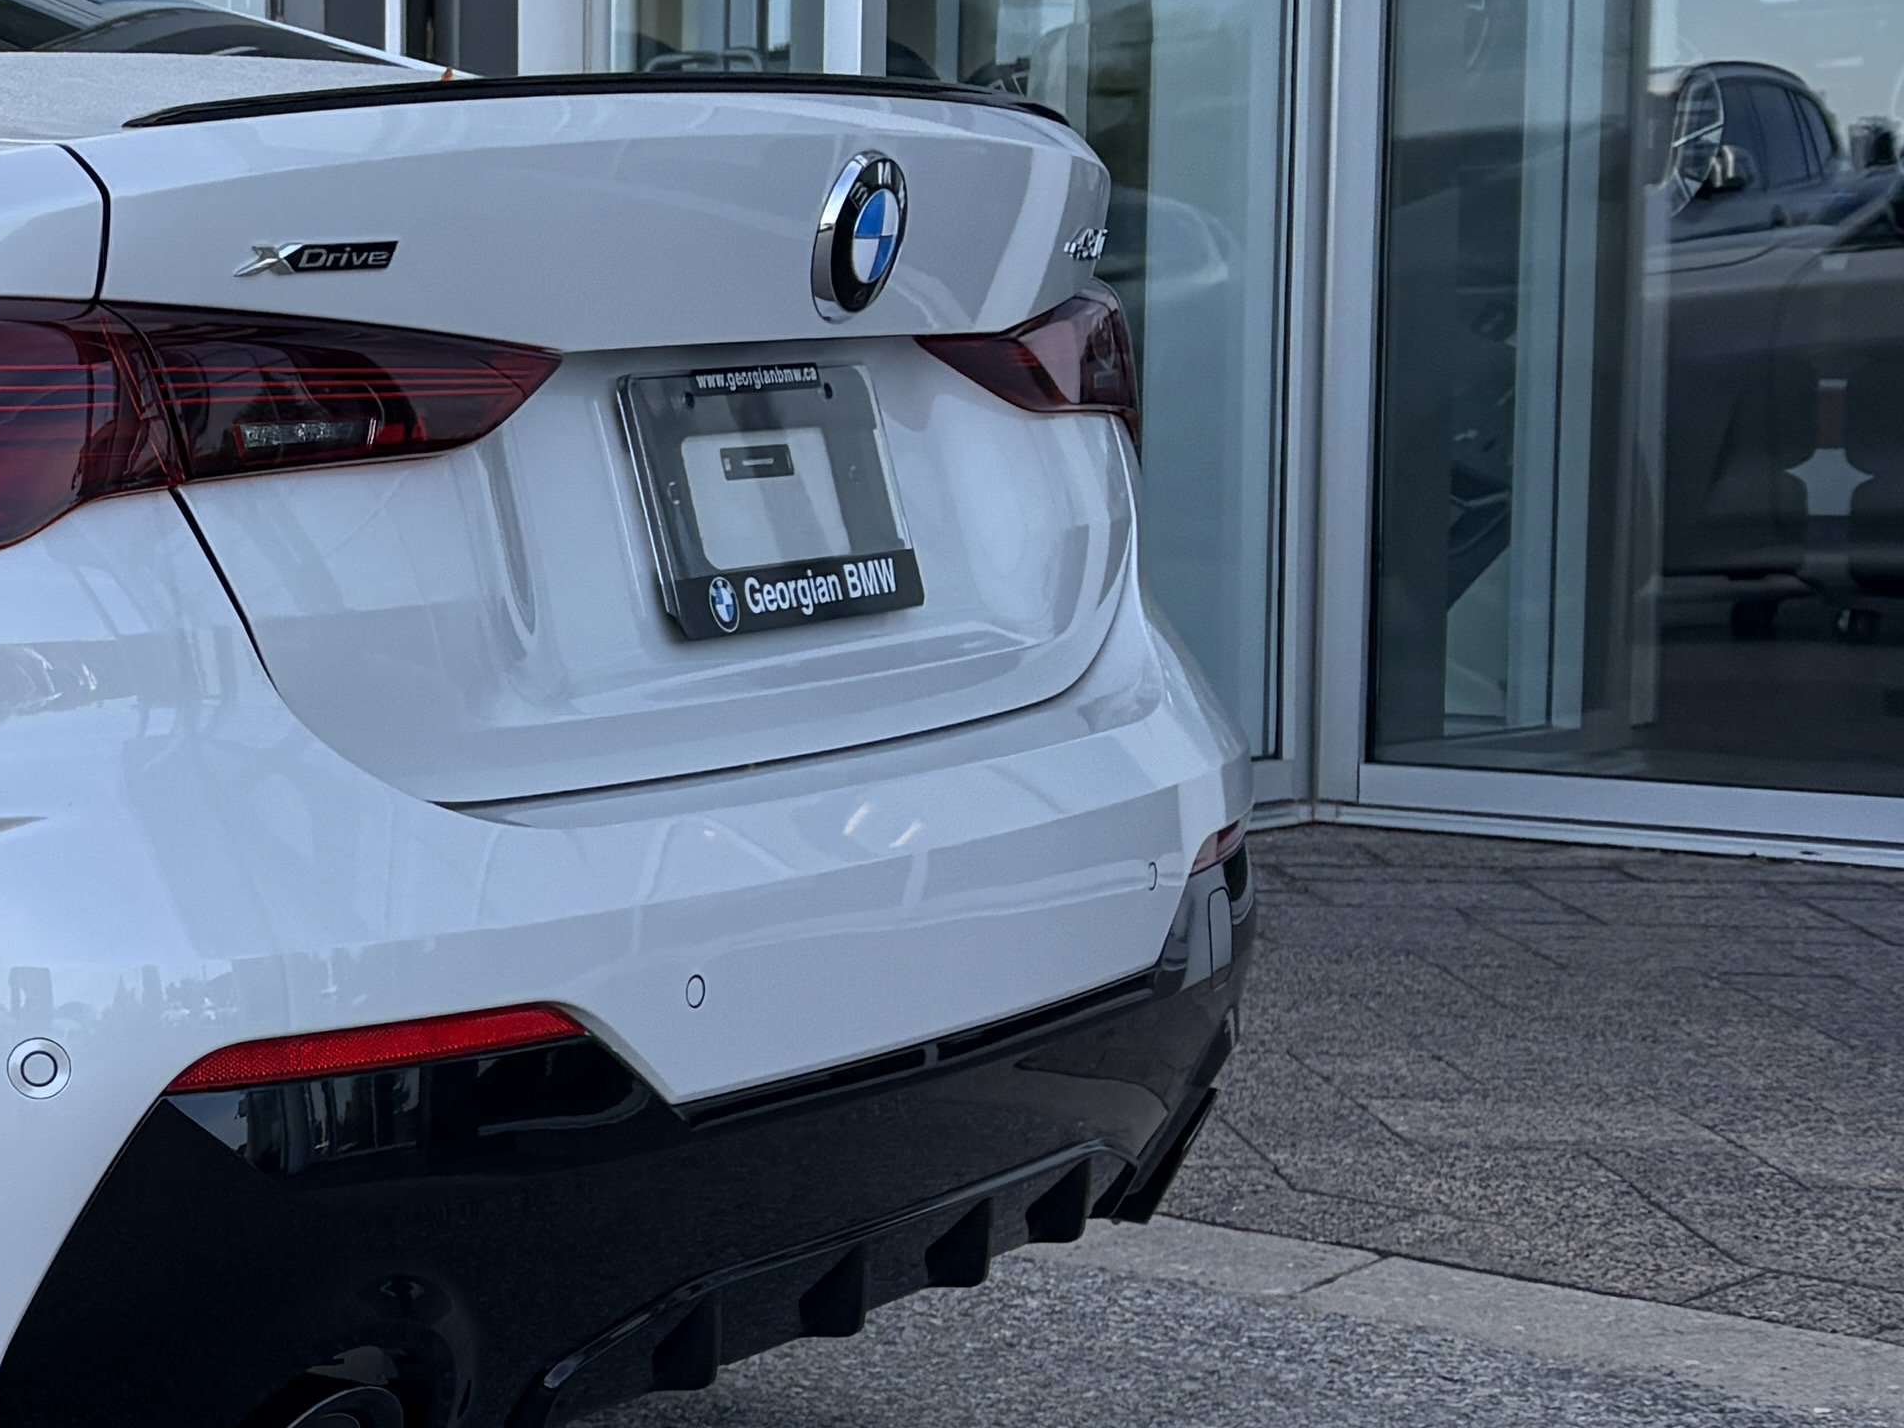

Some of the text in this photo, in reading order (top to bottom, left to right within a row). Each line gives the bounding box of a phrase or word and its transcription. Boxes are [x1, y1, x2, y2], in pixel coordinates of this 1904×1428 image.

[695, 366, 818, 391] www.georgianbmw.ca
[744, 557, 897, 616] Georgian BMW
